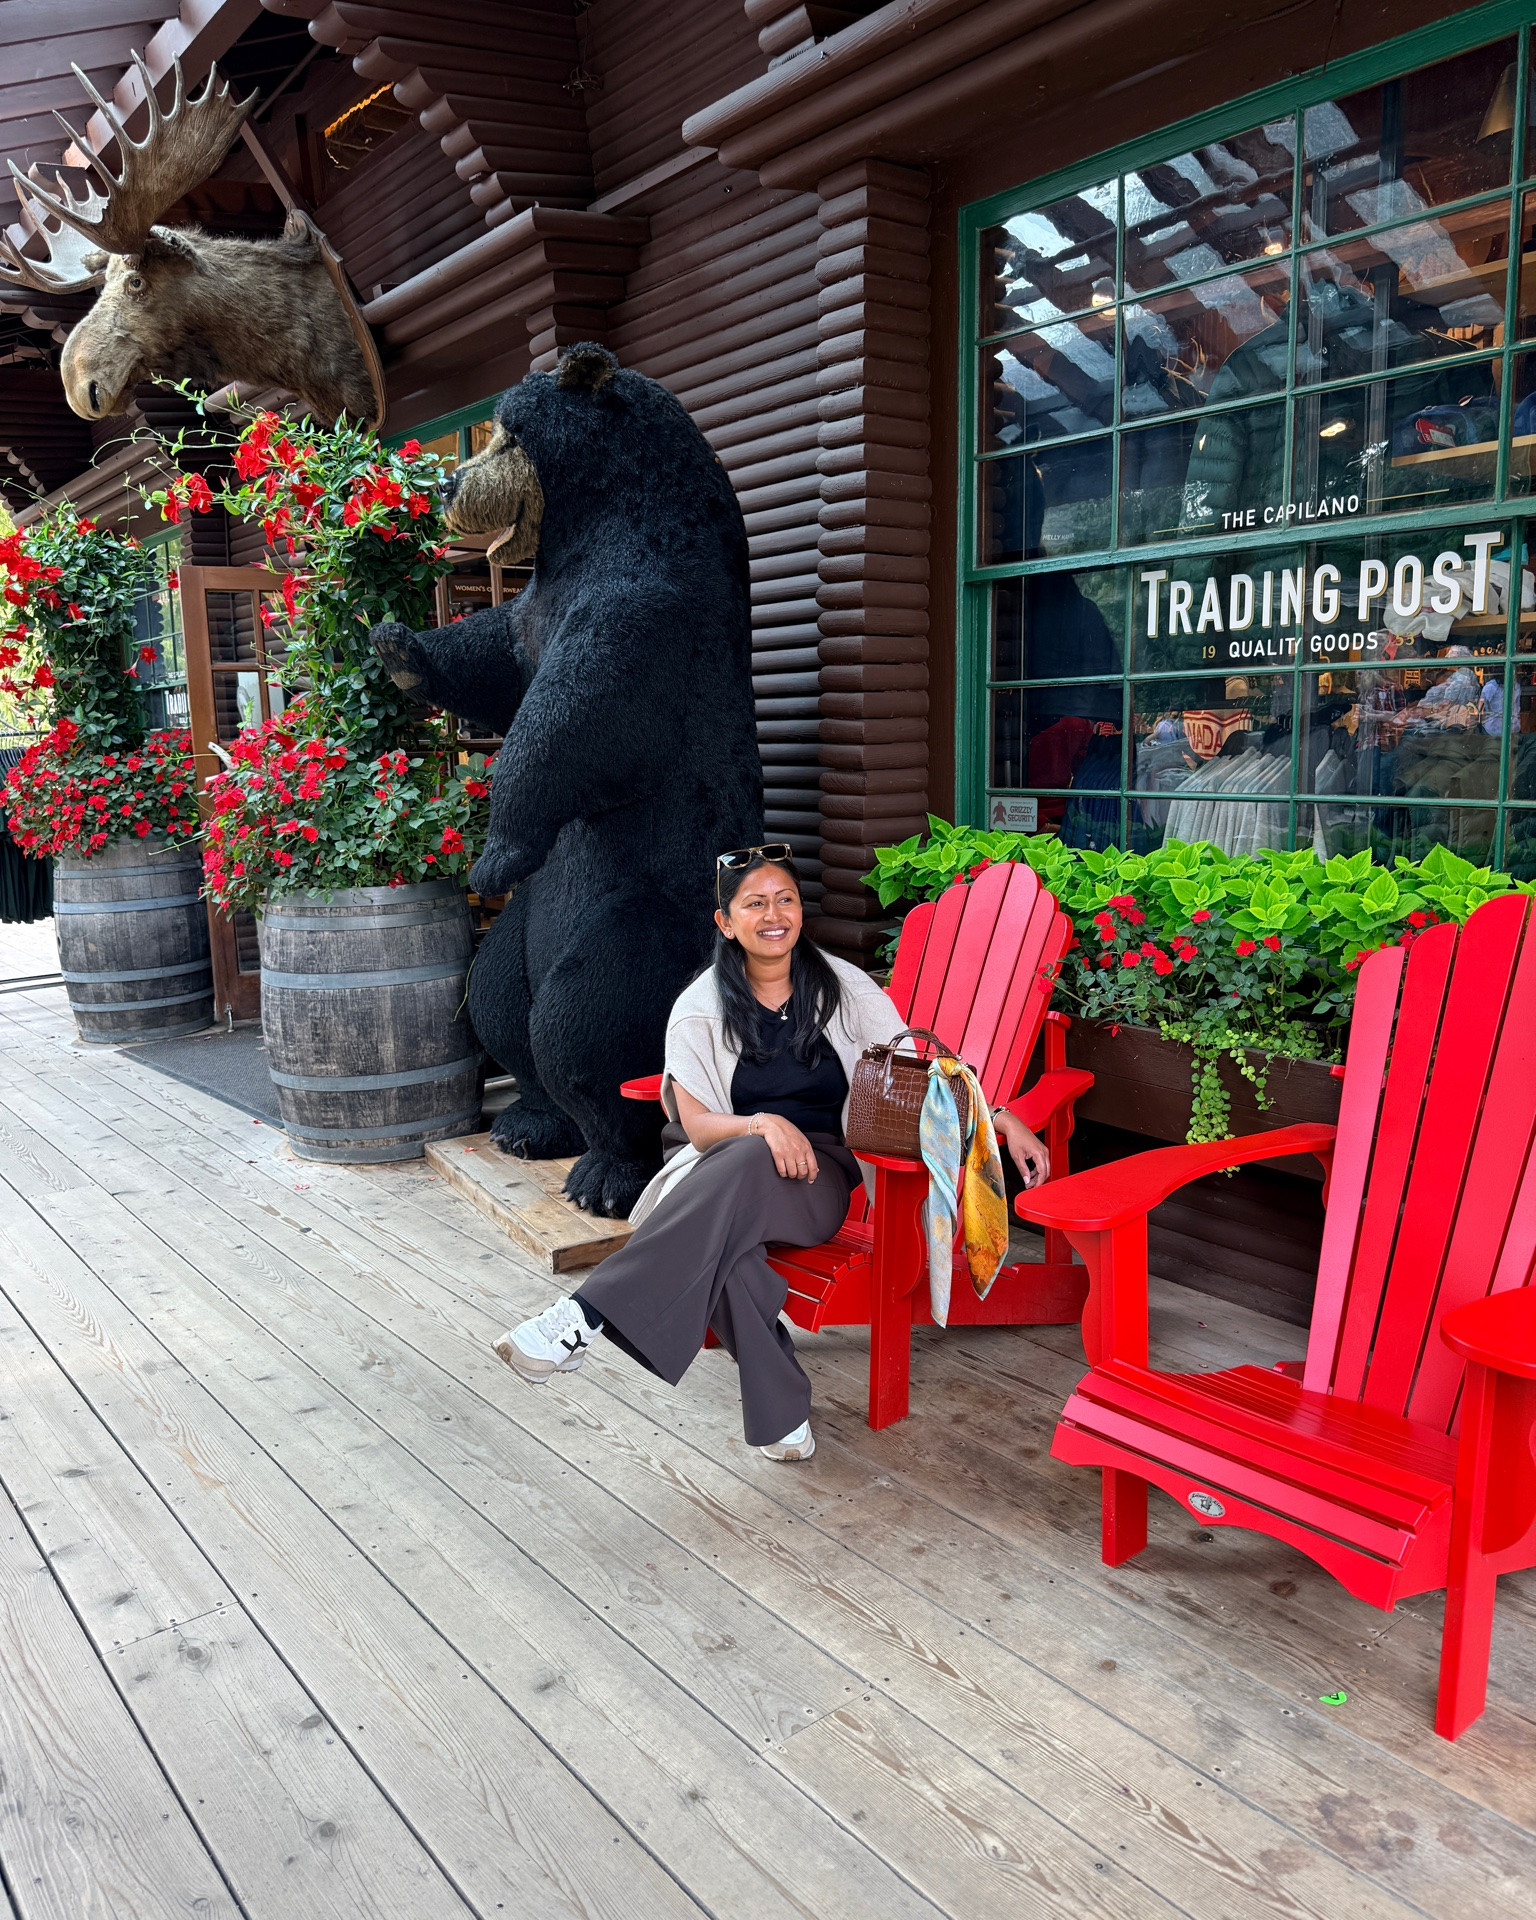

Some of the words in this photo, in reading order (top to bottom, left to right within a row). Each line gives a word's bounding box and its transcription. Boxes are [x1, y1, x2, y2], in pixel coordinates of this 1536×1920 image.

[1222, 509, 1256, 530] THE
[1263, 494, 1359, 524] CAPILANO
[454, 584, 486, 593] WOMEN'S
[1140, 562, 1342, 639] TRADING
[1357, 531, 1505, 622] POST
[1201, 645, 1216, 659] 19
[1228, 637, 1303, 658] QUALITY
[1310, 631, 1378, 652] GOODS
[1395, 631, 1415, 646] 53
[1007, 814, 1036, 823] SECURITY
[1009, 805, 1033, 814] GRIZZLY
